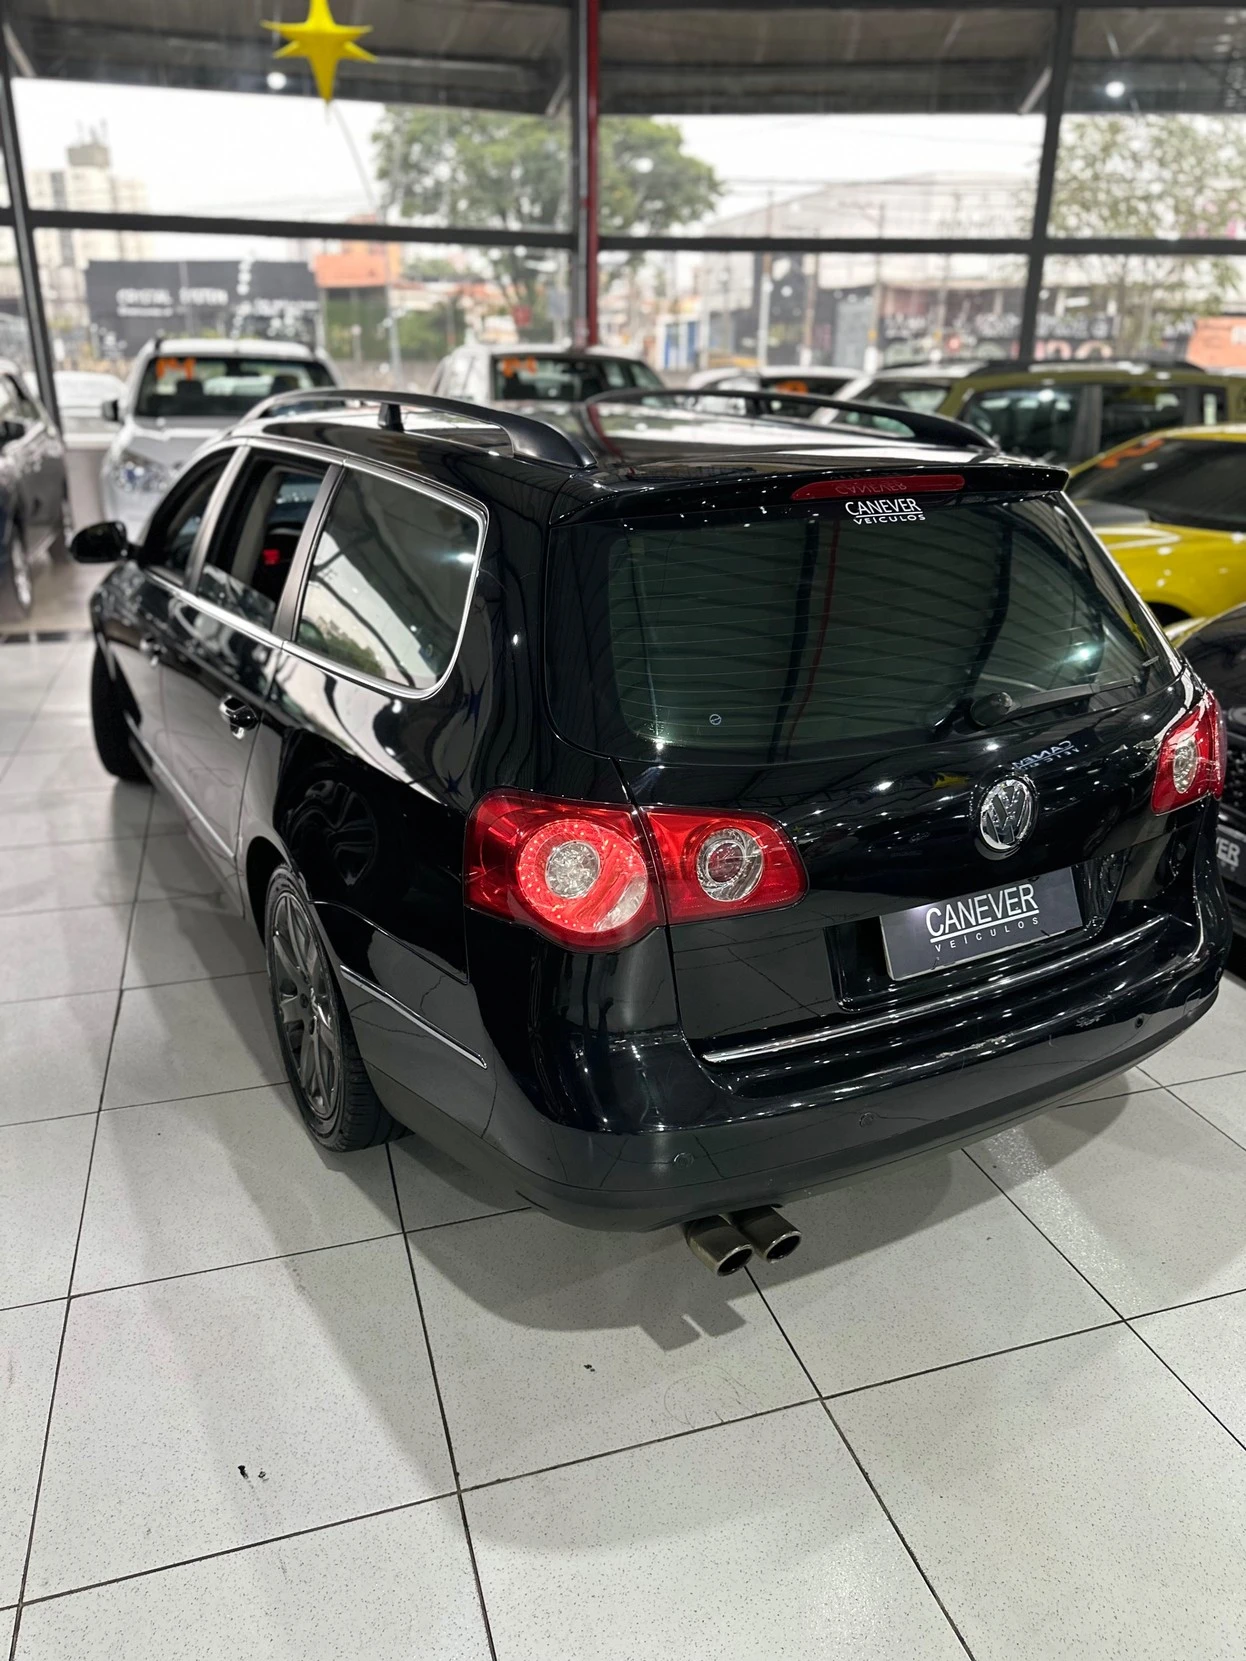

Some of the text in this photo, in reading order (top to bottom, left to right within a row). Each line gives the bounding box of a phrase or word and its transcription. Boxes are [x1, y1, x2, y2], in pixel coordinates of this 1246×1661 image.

[845, 498, 921, 516] CANEVER
[853, 514, 926, 525] VEICULOS
[1216, 836, 1240, 865] ER
[926, 883, 1038, 937] CANEVER
